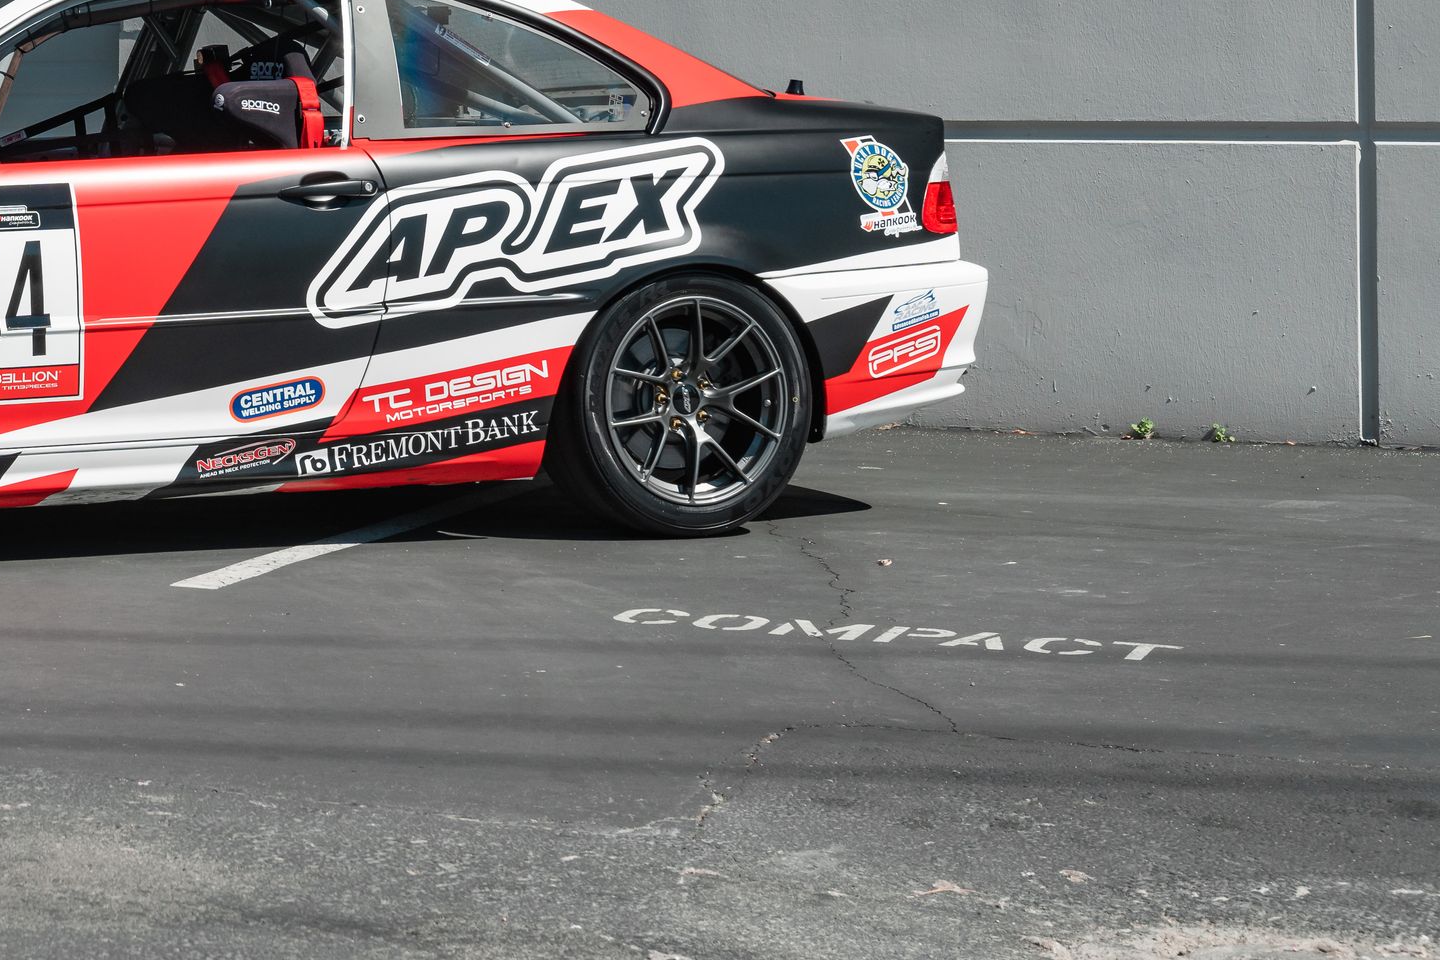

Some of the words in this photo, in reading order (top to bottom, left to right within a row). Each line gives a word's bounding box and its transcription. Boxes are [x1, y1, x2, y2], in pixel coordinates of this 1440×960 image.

[854, 145, 872, 176] LUCKY
[874, 145, 895, 160] DOG
[872, 197, 891, 207] RACING
[346, 166, 692, 292] APEX
[240, 382, 316, 409] CENTRAL
[362, 388, 413, 413] TC
[425, 360, 549, 402] DESIGN
[241, 402, 282, 418] WELDING
[283, 395, 317, 409] SUPPLY
[386, 385, 533, 424] MOTORSPORTS
[200, 470, 218, 479] AHEAD
[225, 463, 239, 474] NECK
[240, 458, 271, 471] PROTECTION
[612, 608, 1184, 661] COMPACT
